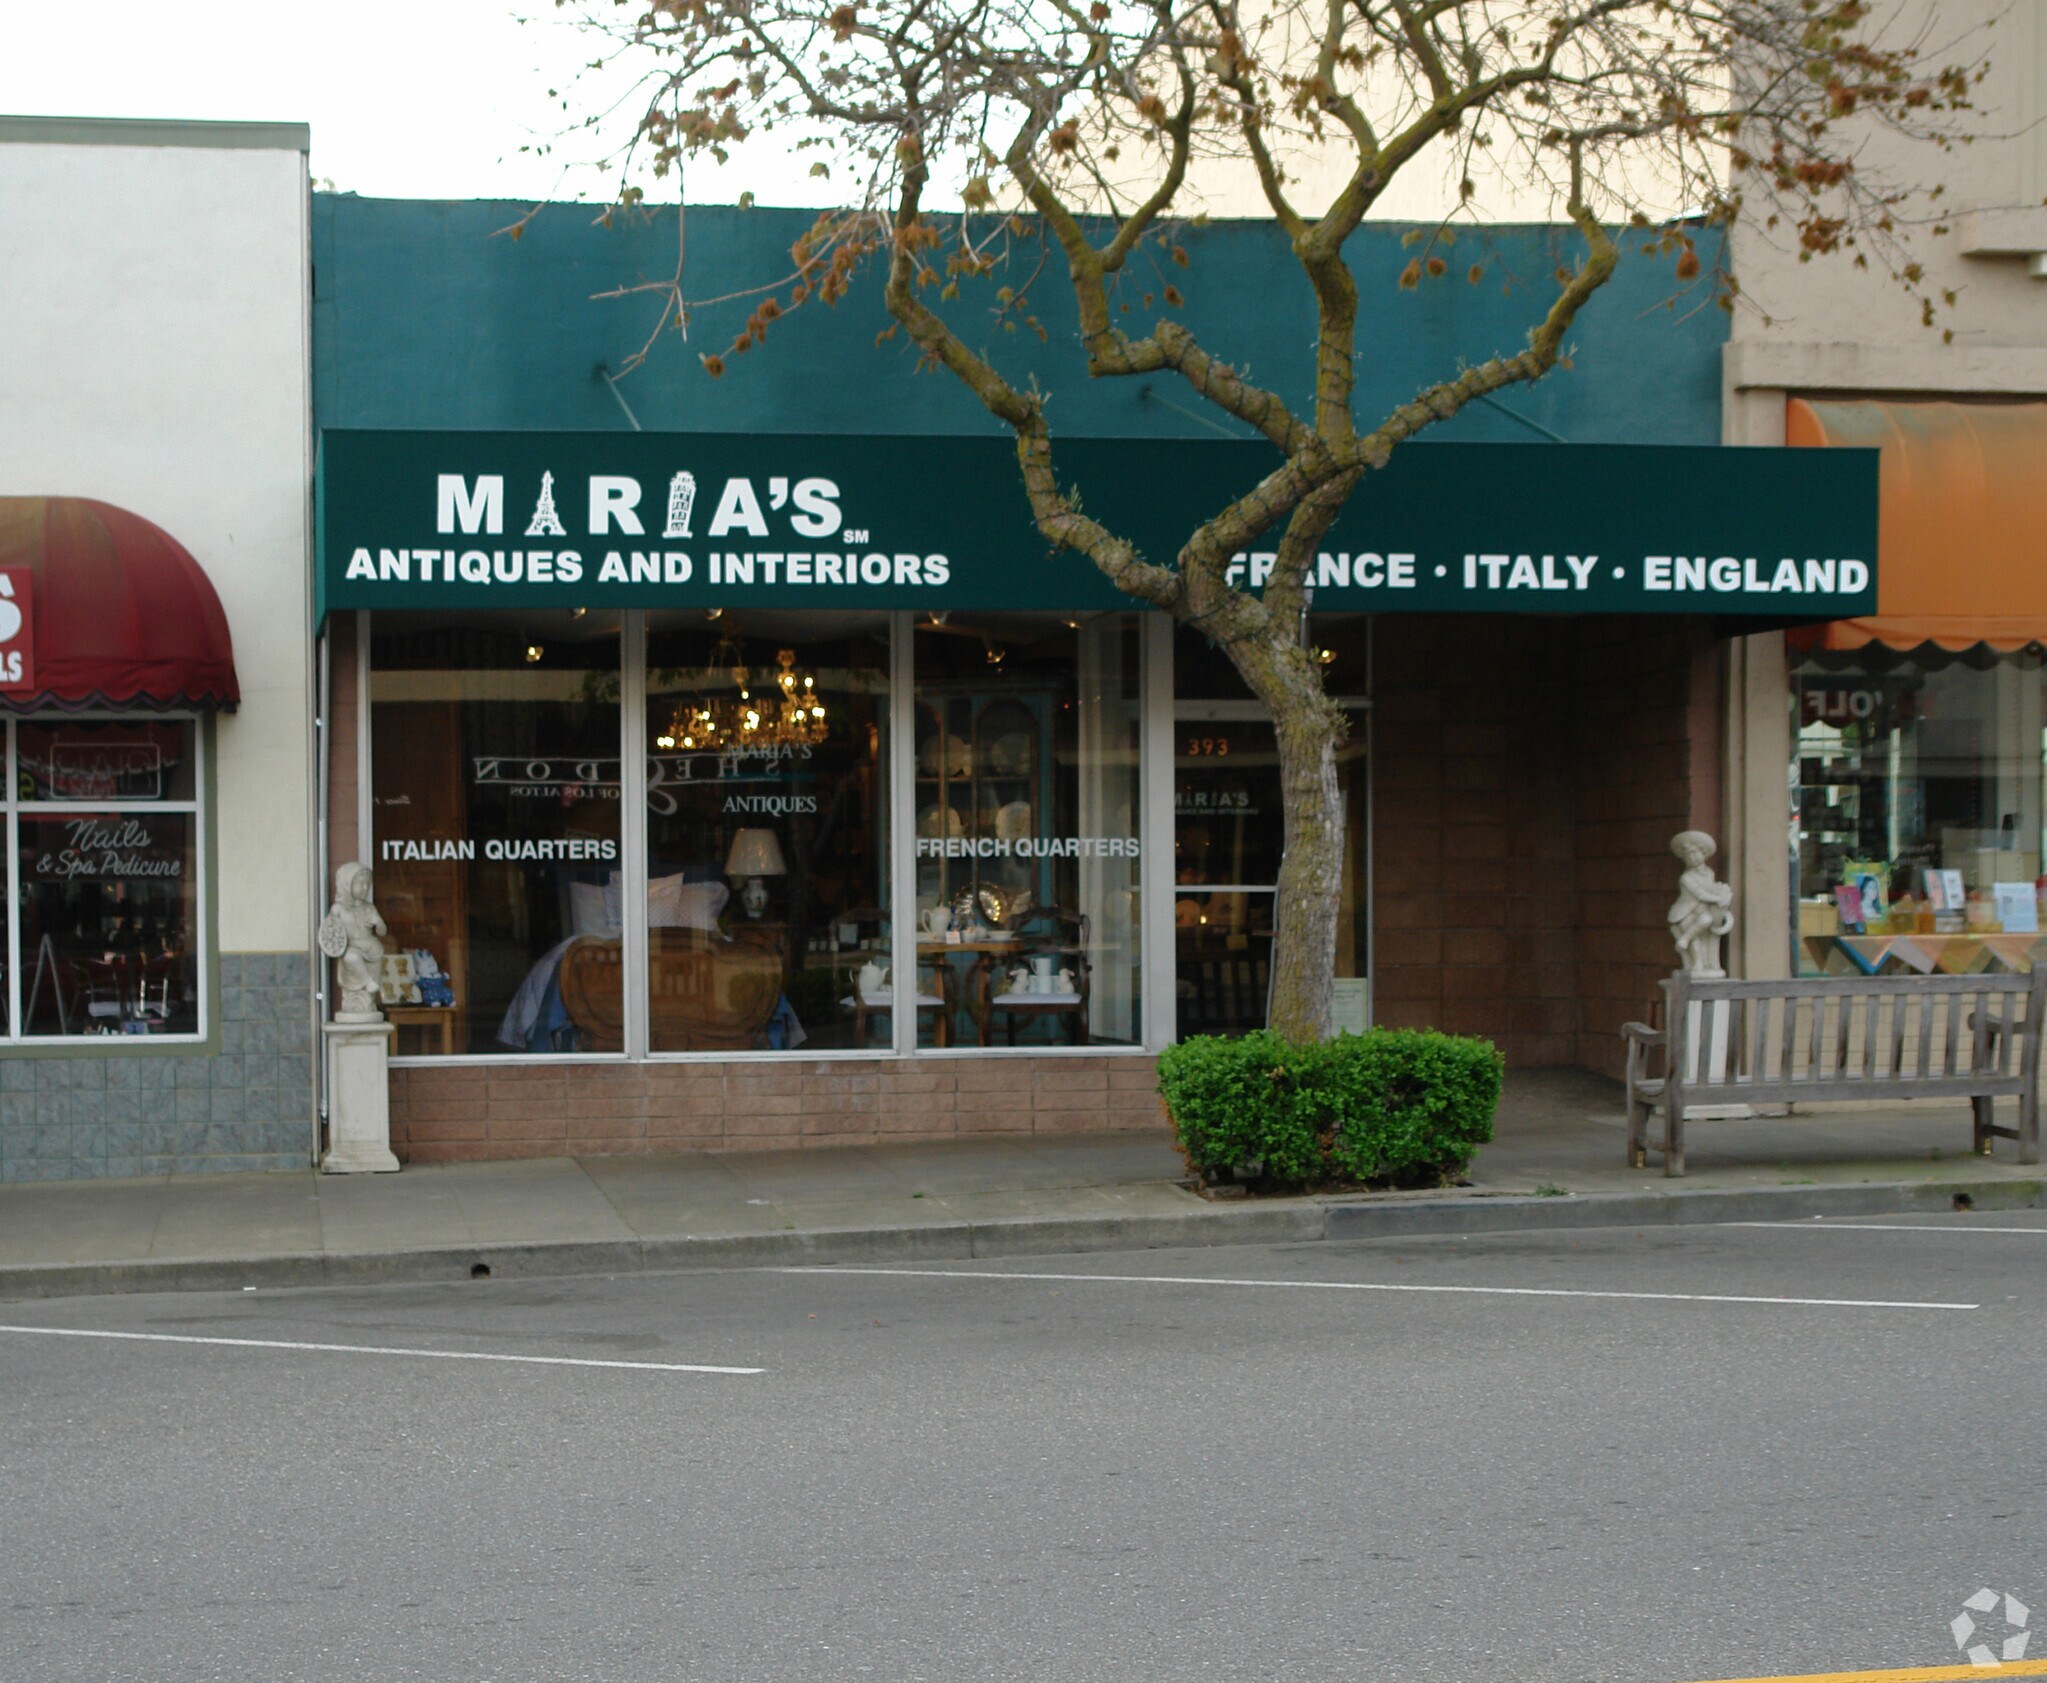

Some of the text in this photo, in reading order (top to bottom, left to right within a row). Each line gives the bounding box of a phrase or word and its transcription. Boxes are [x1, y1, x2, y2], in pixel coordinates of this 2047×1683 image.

[346, 549, 950, 585] ANTIQUES AND INTERIORS
[1463, 555, 1598, 589] ITALY
[1643, 556, 1869, 594] ENGLAND
[1188, 738, 1228, 756] 393
[722, 796, 818, 817] ANTIQUES
[65, 819, 152, 851] Nails
[916, 838, 1141, 858] FRENCH QUARTERS
[382, 839, 617, 861] ITALIAN QUARTERS
[37, 850, 180, 880] & Spa Pedicure
